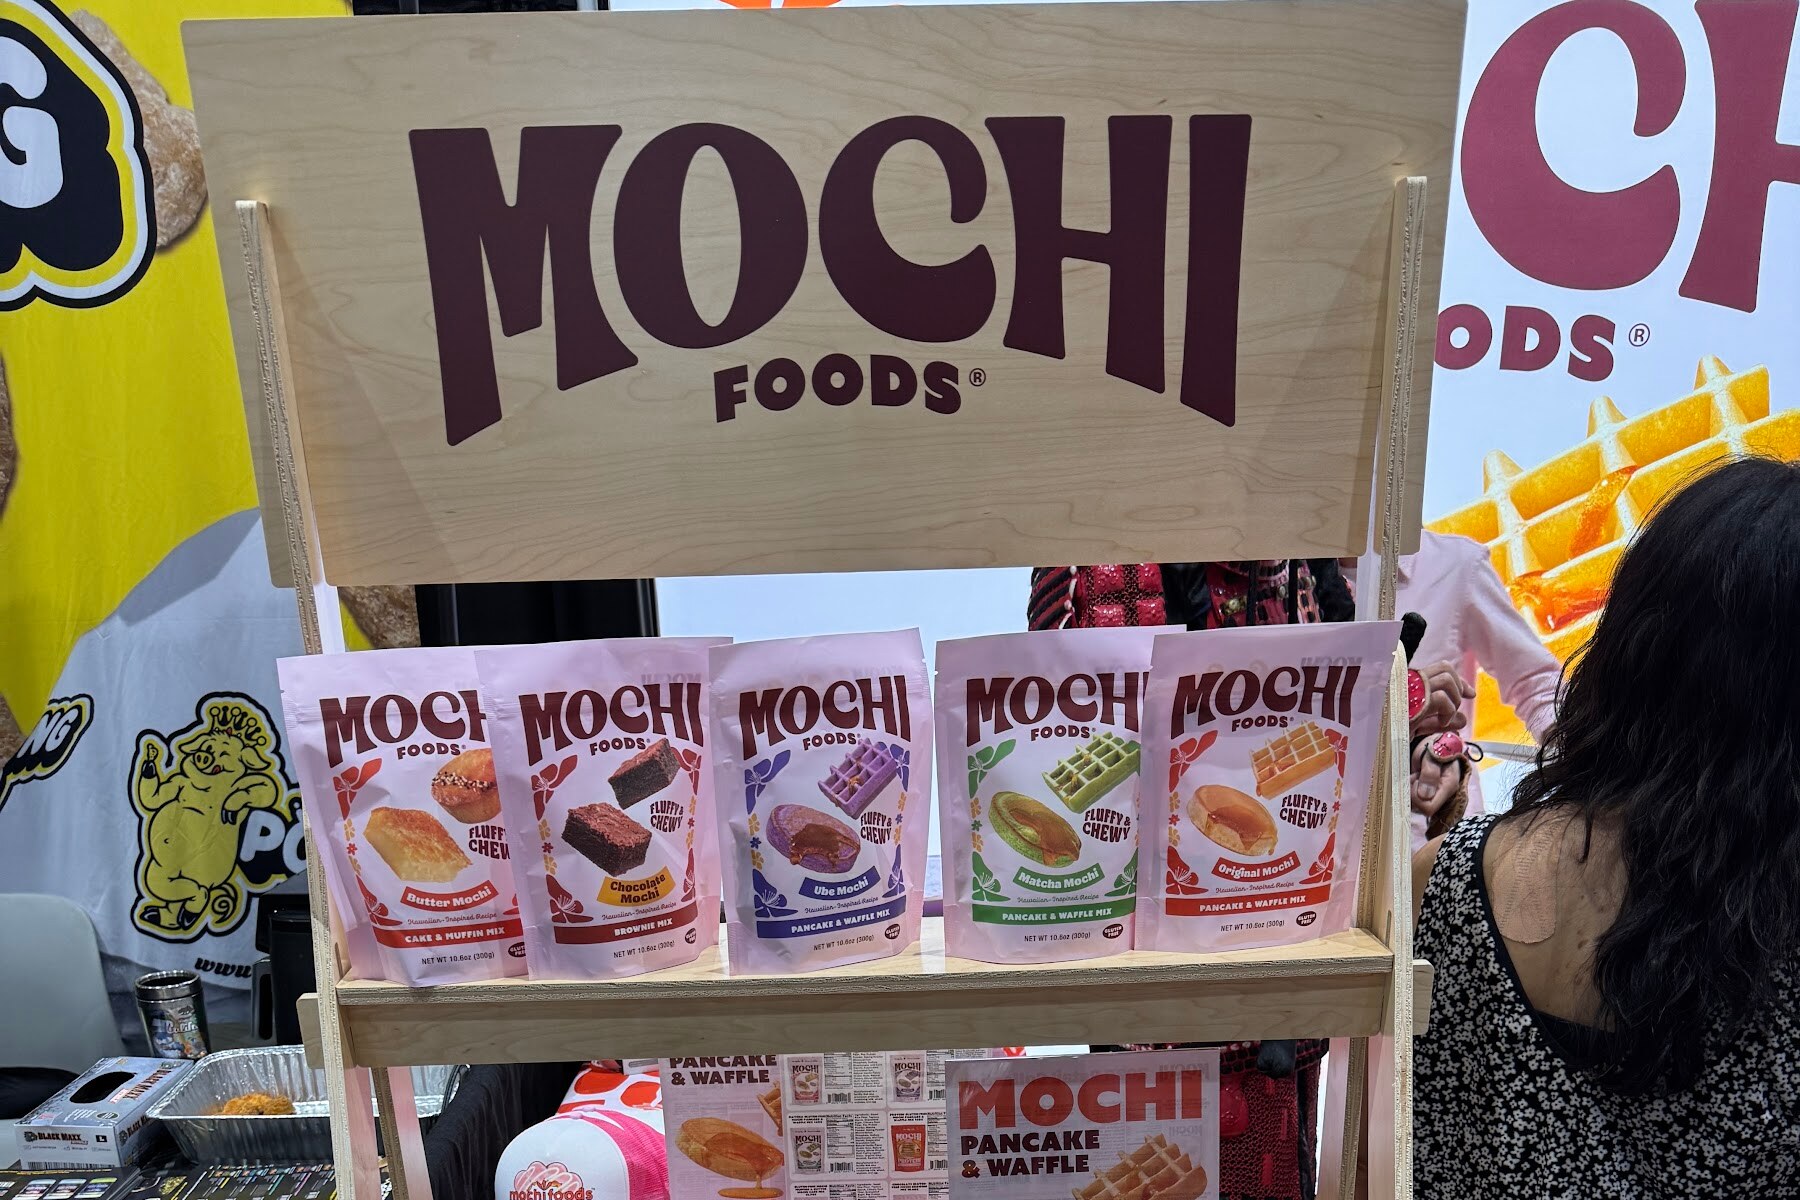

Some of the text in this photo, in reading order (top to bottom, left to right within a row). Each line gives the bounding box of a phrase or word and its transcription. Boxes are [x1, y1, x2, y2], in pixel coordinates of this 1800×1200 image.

[409, 114, 1252, 446] MOCHI
[1171, 666, 1361, 739] MOCHI
[519, 683, 704, 767] MOCHI
[738, 675, 911, 760] MOCHI
[650, 800, 683, 815] FLUFFY &
[1282, 794, 1327, 812] FLUFFY &
[650, 814, 683, 832] CHEWY
[860, 812, 892, 826] FLUFFY &
[1085, 808, 1131, 826] FLUFFY &
[1279, 808, 1327, 829] CHEWY
[860, 827, 892, 844] CHEWY
[1083, 822, 1130, 842] CHEWY
[1219, 857, 1294, 879] Original Mochi
[610, 874, 666, 893] Chocolate
[814, 876, 868, 896] Ube Mochi
[1018, 868, 1099, 889] Matcha Mochi
[407, 886, 491, 907] Butter Mochi
[621, 888, 660, 903] Mochi
[1003, 912, 1047, 920] PANCAKE
[1059, 910, 1093, 919] WAFFLE
[1096, 908, 1112, 916] MIX
[1200, 902, 1243, 912] PANCAKE
[1255, 898, 1287, 907] WAFFLE
[614, 918, 673, 936] BROWNIE MIX
[791, 921, 833, 934] PANCAKE
[844, 913, 874, 925] WAFFLE
[876, 908, 890, 918] MIX
[405, 935, 432, 943] CAKE
[446, 929, 483, 940] MUFFIN
[669, 1054, 777, 1068] PANCAKE
[792, 1065, 819, 1073] MOCHI
[895, 1063, 921, 1071] MOCHI
[671, 1070, 770, 1086] & WAFFLE
[958, 1070, 1202, 1129] MOCHI
[38, 1132, 61, 1141] BLACK
[795, 1135, 821, 1144] MOCHI
[896, 1133, 921, 1141] MOCHI
[961, 1130, 1100, 1155] PANCAKE
[962, 1155, 1089, 1178] & WAFFLE
